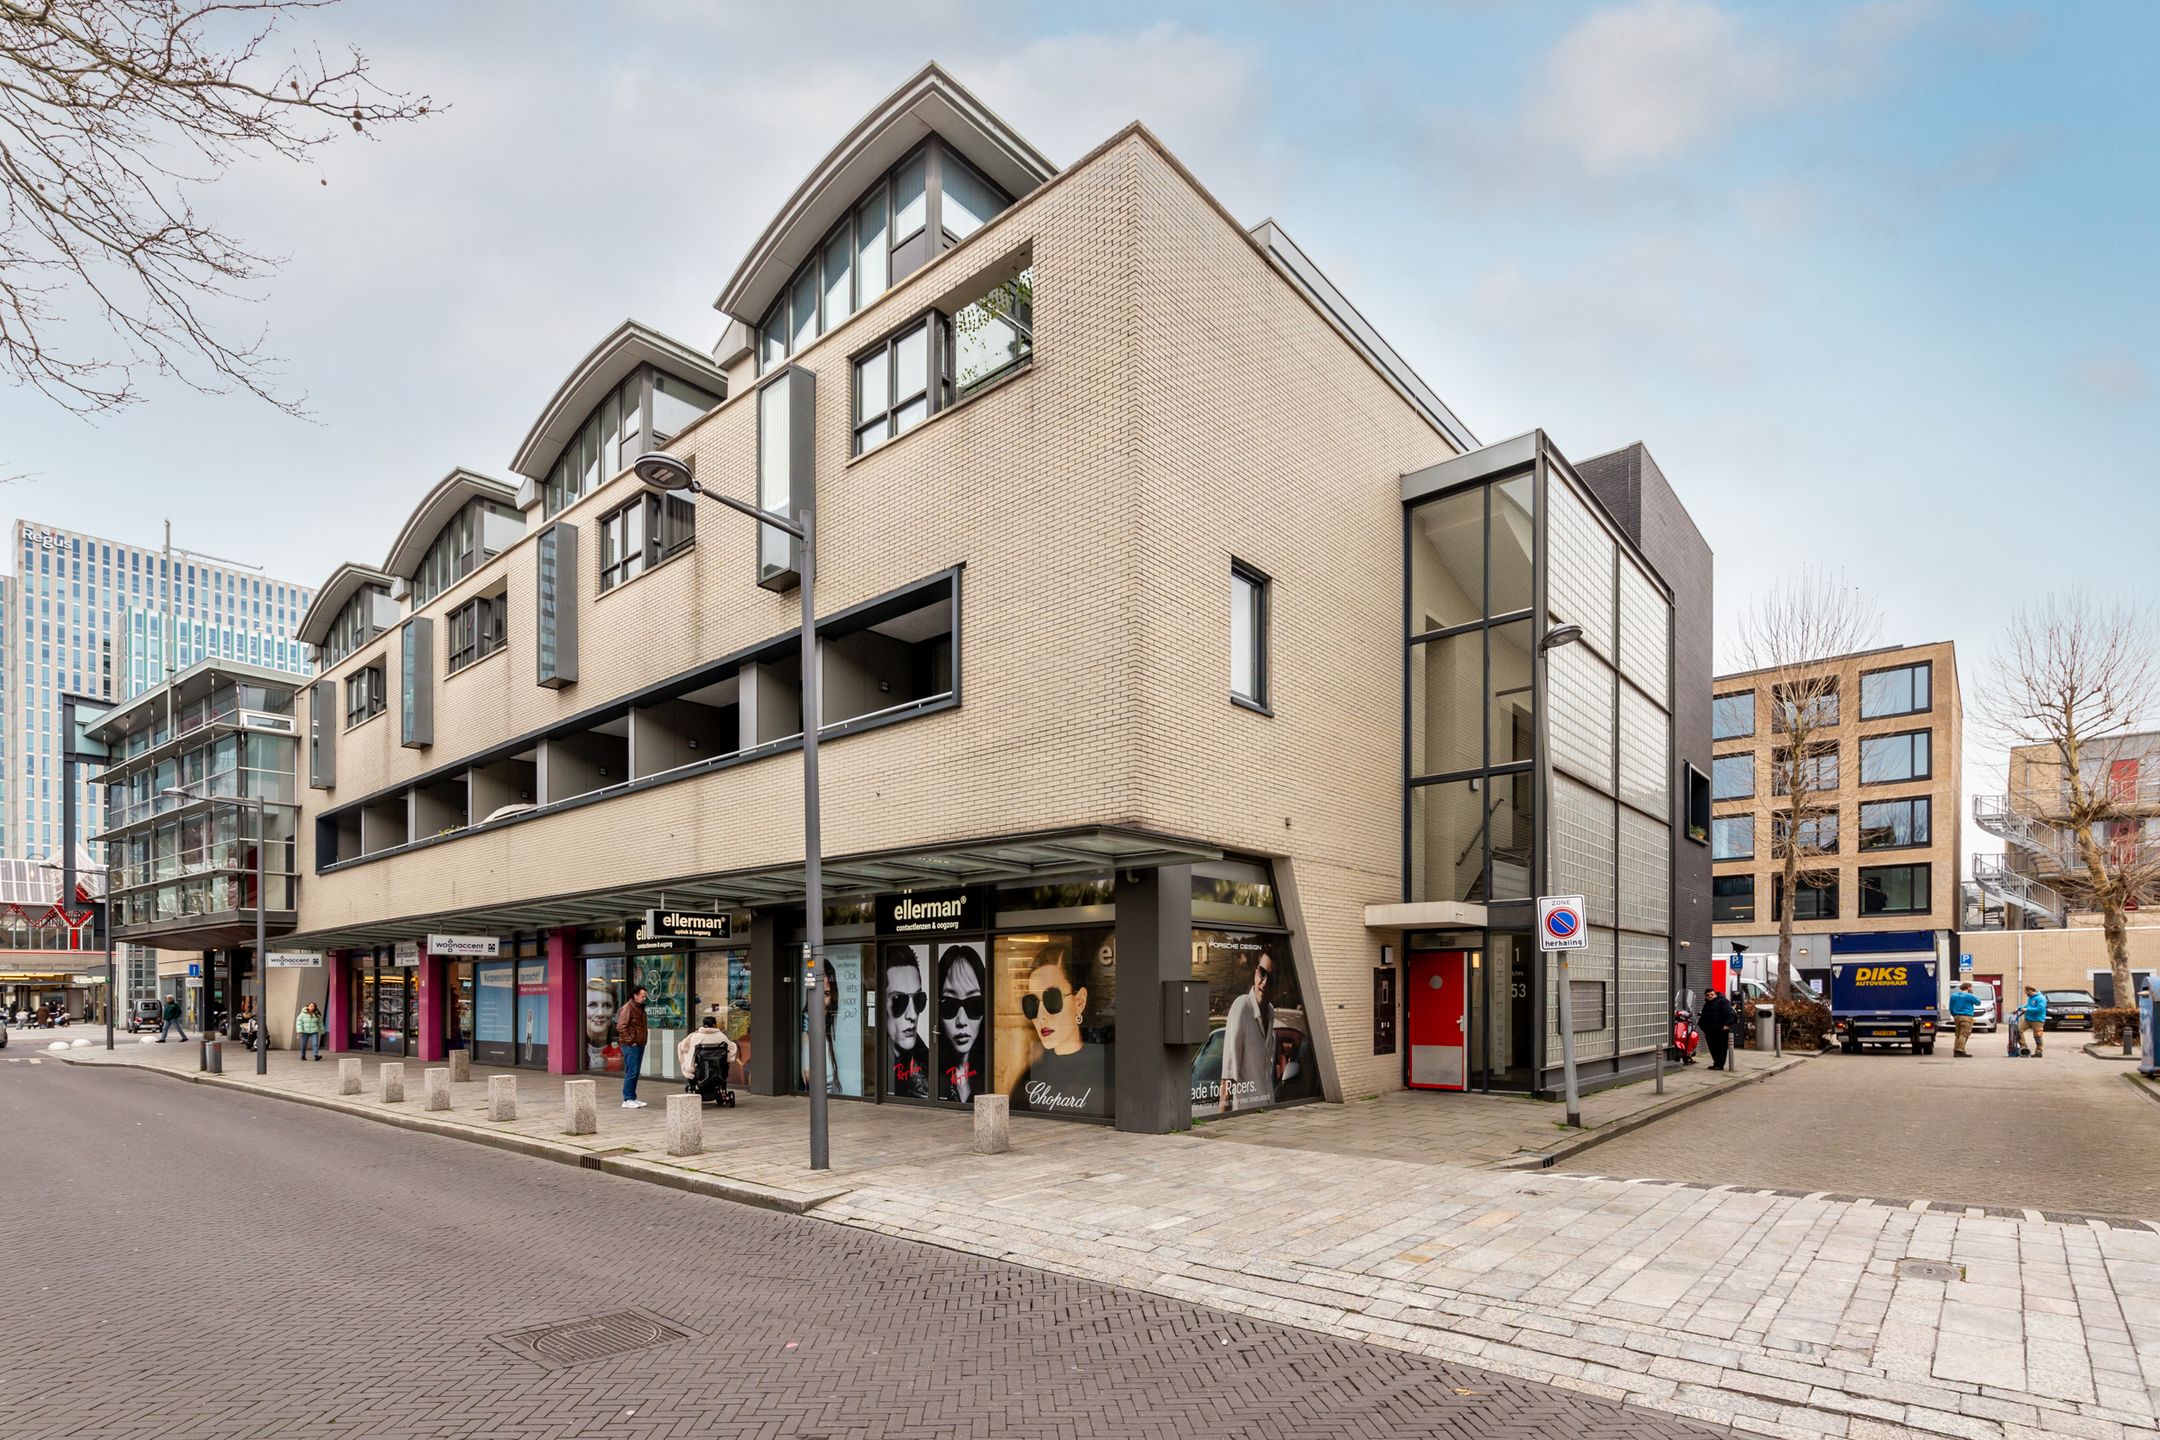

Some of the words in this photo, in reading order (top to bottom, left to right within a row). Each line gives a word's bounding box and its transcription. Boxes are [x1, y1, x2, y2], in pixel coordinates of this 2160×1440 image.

[22, 527, 72, 550] Regus
[663, 913, 722, 929] ellerman
[896, 923, 932, 932] contactlenzen
[931, 921, 936, 930] &
[936, 921, 959, 930] oogzorg
[435, 940, 484, 950] woonaccent
[1209, 942, 1239, 950] PORSCHE
[1545, 940, 1582, 948] herhaling
[1514, 947, 1520, 962] 1
[1855, 967, 1908, 981] DIKS
[1511, 983, 1526, 998] 53
[1025, 1080, 1091, 1110] Chopard
[1191, 1083, 1208, 1100] ade
[1210, 1081, 1222, 1098] for
[1225, 1080, 1257, 1095] Racers.
